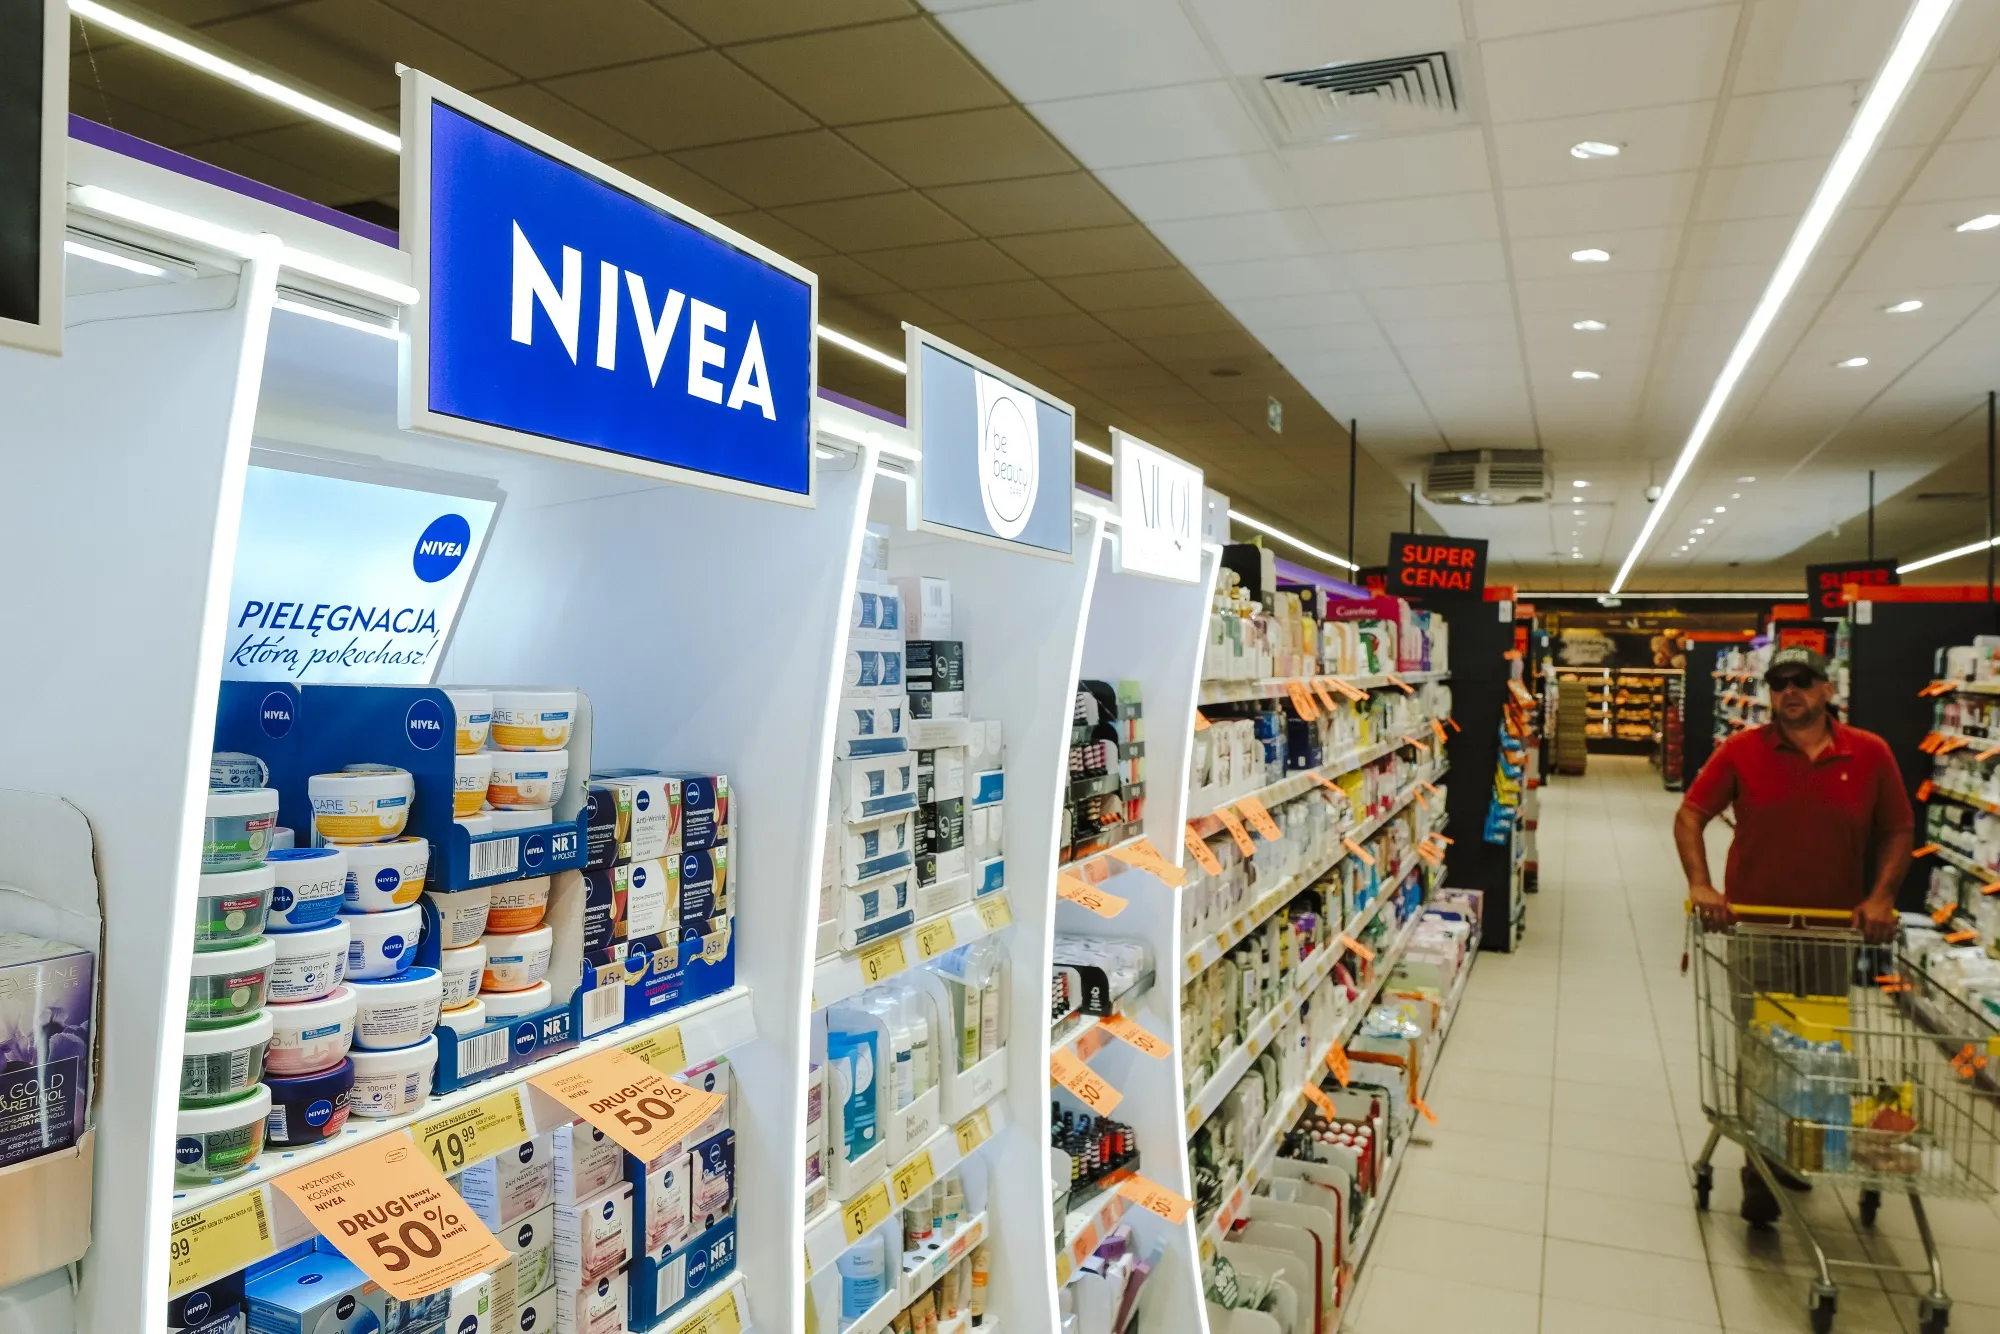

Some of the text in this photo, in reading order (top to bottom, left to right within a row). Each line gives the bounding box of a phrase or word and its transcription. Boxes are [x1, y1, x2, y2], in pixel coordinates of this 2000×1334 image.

[510, 219, 777, 421] NIVEA
[993, 424, 1008, 454] be
[993, 451, 1028, 493] beauty
[419, 539, 462, 557] NIVEA
[1401, 544, 1477, 568] SUPER
[1400, 567, 1472, 591] CENA!
[237, 600, 440, 638] PIELĘGNACJA,
[229, 633, 439, 679] która pokochasz!
[263, 709, 291, 721] NIVEA
[410, 718, 441, 731] NIVEA
[312, 799, 344, 811] CARE
[636, 813, 667, 825] Anti-Wrinkle
[526, 847, 545, 856] NIVEA
[552, 834, 569, 853] NR
[572, 834, 578, 849] 1
[552, 853, 558, 861] W
[377, 875, 399, 884] NIVEA
[633, 873, 646, 881] NIVEA
[298, 879, 337, 896] CARE
[490, 895, 525, 906] CARE
[384, 943, 403, 951] NIVEA
[705, 940, 721, 955] 65+
[923, 935, 931, 956] 8
[300, 965, 313, 973] 100
[656, 955, 675, 971] 55+
[868, 959, 878, 981] 9
[601, 972, 622, 987] 45+
[516, 1015, 570, 1045] NIVEA NR 1
[643, 1037, 655, 1047] CENY
[186, 1068, 200, 1077] 100
[9, 1073, 65, 1100] GOLD
[366, 1085, 380, 1093] 100
[642, 1076, 663, 1090] produkt
[704, 1078, 716, 1087] NIVEA
[568, 1088, 590, 1101] NIVEA
[588, 1083, 644, 1115] DRUGI
[49, 1105, 65, 1115] MOC
[308, 1108, 331, 1118] NIVEA
[614, 1083, 682, 1136] 50%
[424, 1119, 448, 1134] ZAWSZE
[448, 1112, 467, 1126] NISKIE
[466, 1106, 482, 1118] CENY
[208, 1126, 253, 1147] CARE
[5, 1148, 26, 1160] OCZY
[432, 1125, 475, 1172] 19 99
[519, 1147, 534, 1156] NIVEA
[297, 1170, 345, 1192] WSZYSTKIE
[504, 1178, 516, 1189] 24H
[515, 1182, 525, 1191] KREM
[306, 1178, 356, 1202] KOSMETYKI
[406, 1187, 431, 1200] tańszy
[900, 1179, 909, 1200] 9
[314, 1196, 346, 1212] NIVEA
[413, 1192, 442, 1209] produkt
[336, 1196, 414, 1237] DRUGI
[603, 1206, 614, 1215] NIVEA
[180, 1212, 203, 1226] CENY
[608, 1217, 624, 1235] Touch
[854, 1211, 863, 1235] 5
[366, 1204, 460, 1273] 50%
[519, 1231, 534, 1241] NIVEA
[170, 1237, 190, 1260] 99
[688, 1234, 735, 1277] NIVEA NR 1
[709, 1263, 717, 1272] W
[302, 1273, 319, 1284] NIVEA
[599, 1283, 610, 1291] NIVEA
[187, 1302, 209, 1316] NIVEA
[338, 1302, 354, 1314] NIVEA
[199, 1313, 231, 1333] REGENERACJA
[521, 1311, 536, 1322] NIVEA
[458, 1323, 477, 1334] NIVEA
